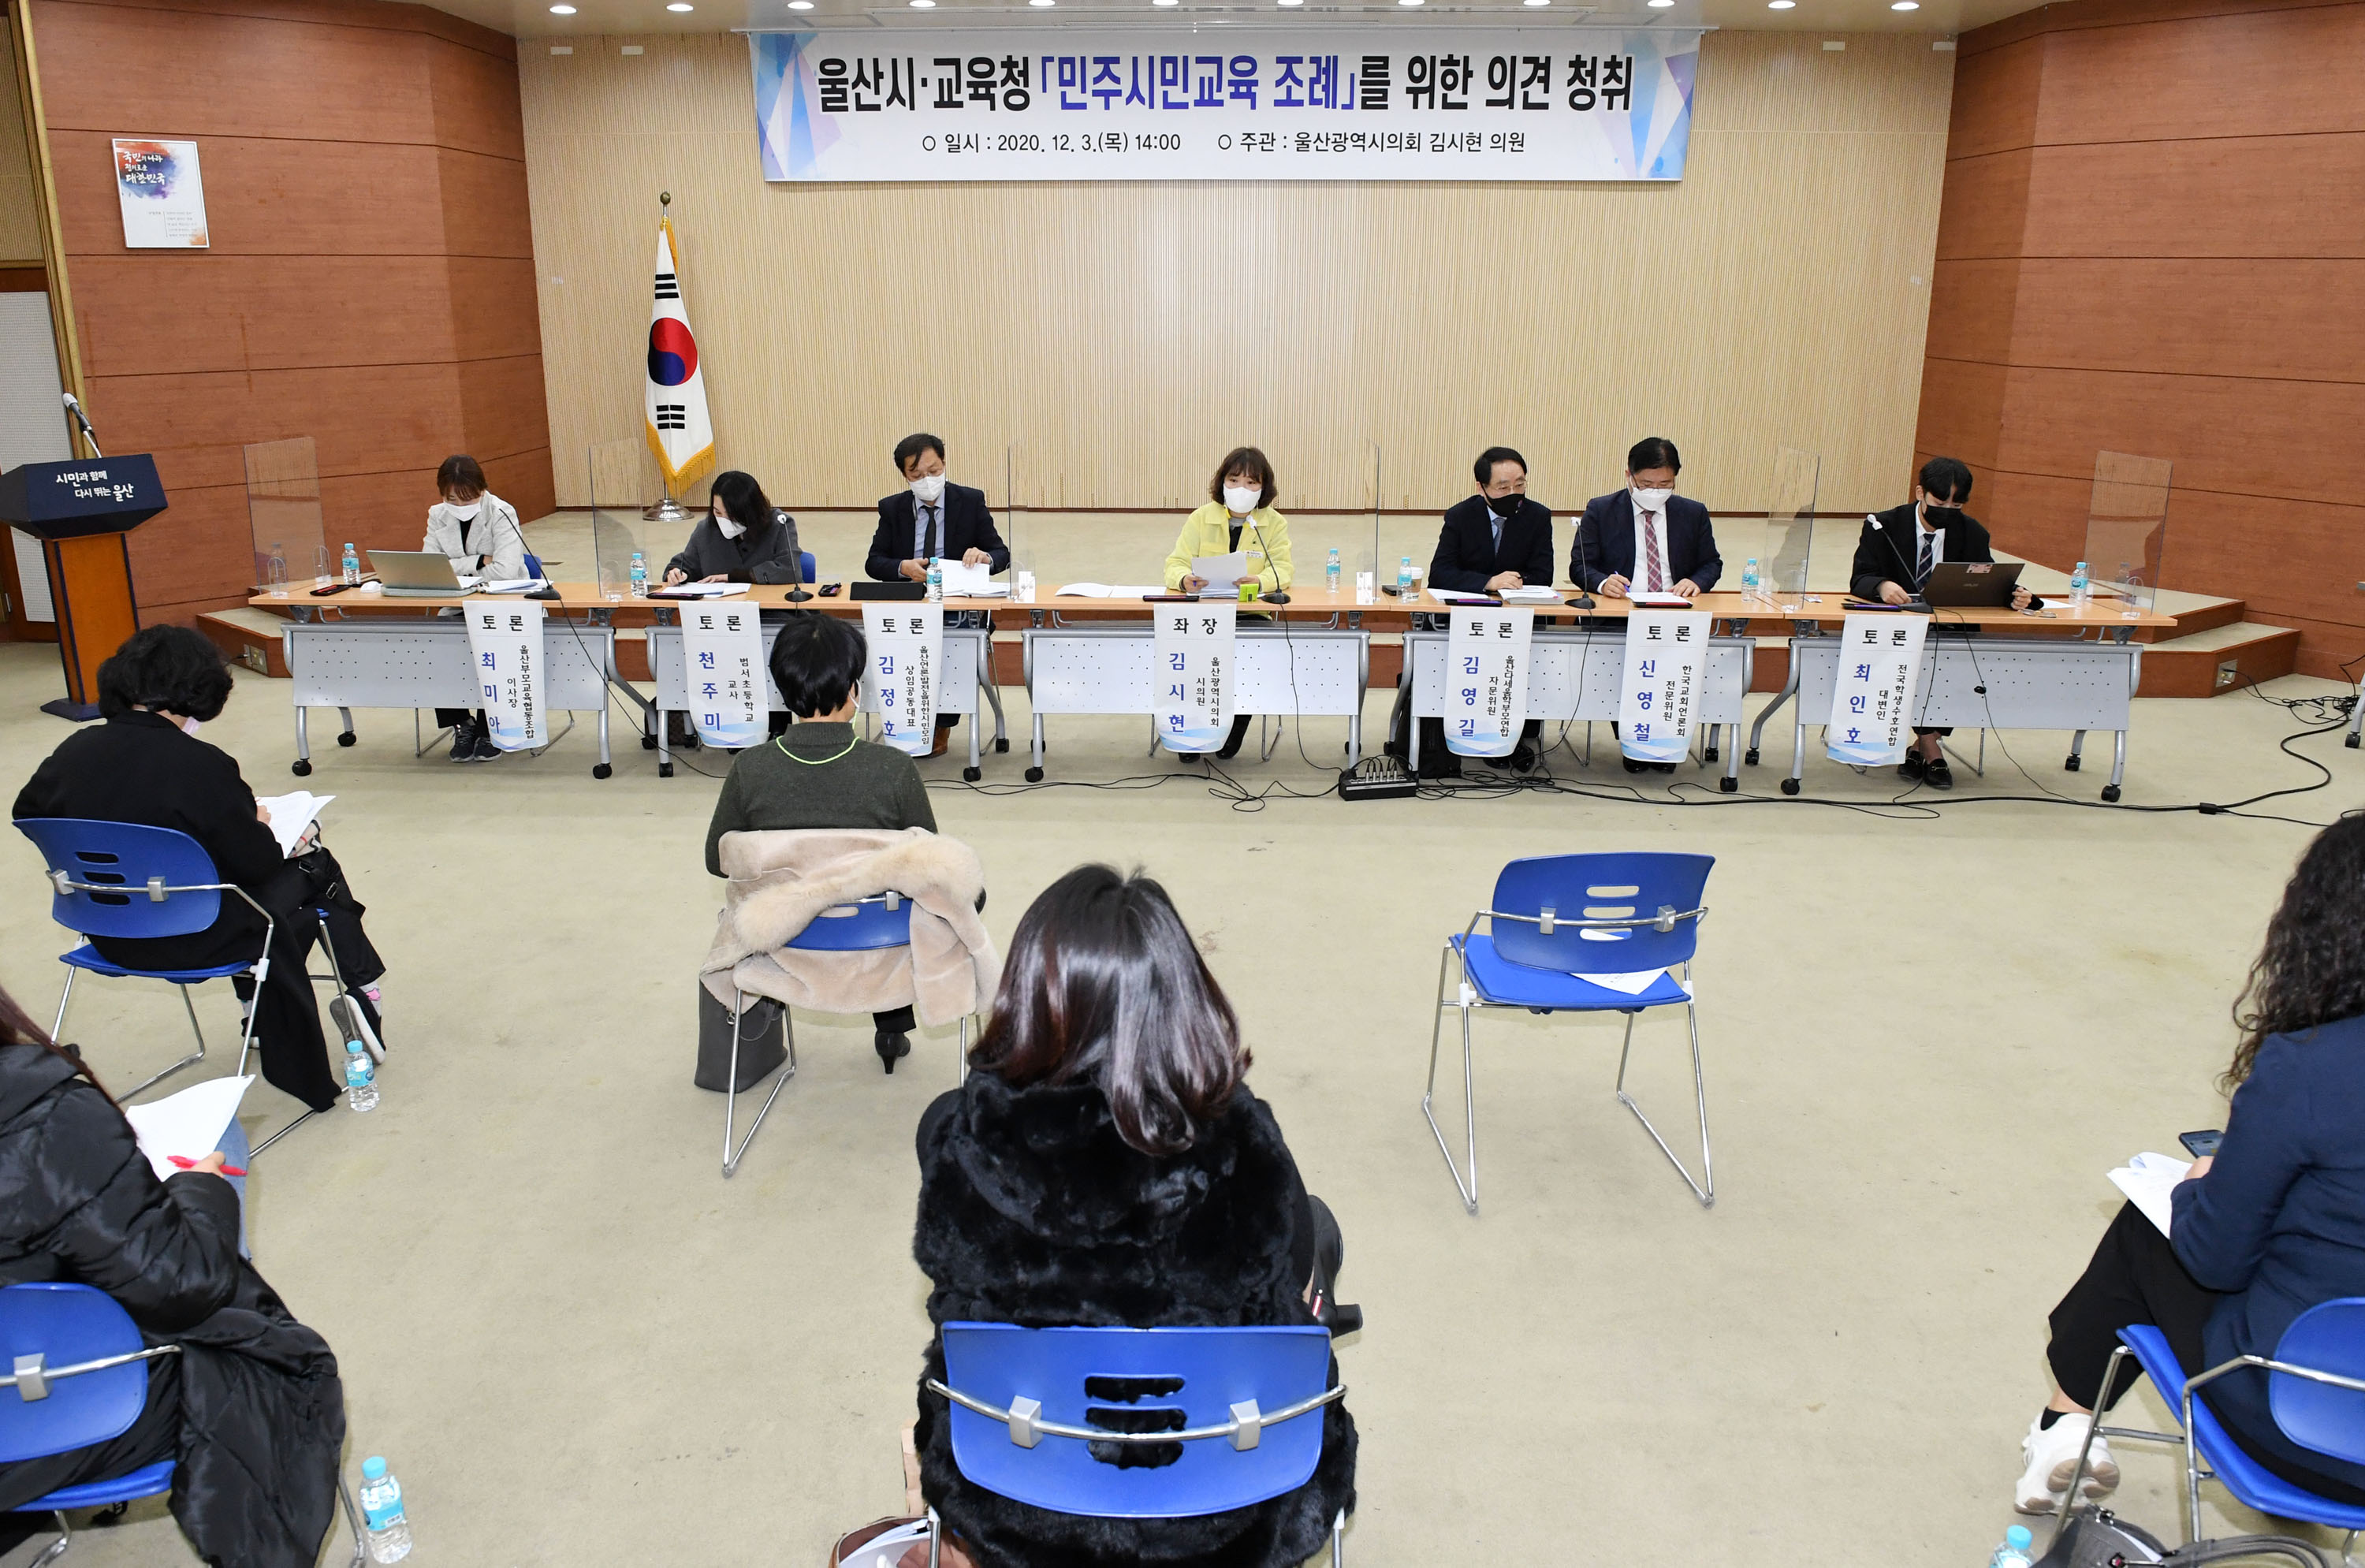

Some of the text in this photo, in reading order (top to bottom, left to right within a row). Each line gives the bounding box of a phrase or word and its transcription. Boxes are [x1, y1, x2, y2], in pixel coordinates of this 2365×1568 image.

[1406, 54, 1473, 110] 위한
[1485, 55, 1551, 110] 의견
[1567, 54, 1633, 111] 청취
[123, 151, 147, 162] 국민의
[945, 133, 980, 153] 일시
[997, 135, 1045, 153] 2020.
[1052, 135, 1074, 153] 12.
[1135, 134, 1181, 151] 14:00
[1240, 132, 1276, 152] 주관
[1294, 132, 1421, 152] 울산광역시의회
[1429, 132, 1482, 152] 김시현
[1490, 132, 1525, 152] 의원
[125, 173, 166, 185] 대한민국
[56, 471, 108, 487] 시민과 함께
[74, 483, 134, 502] 다시 뛰는 울산
[507, 678, 517, 708] 이사장
[520, 645, 534, 739] 울산부모교육협동조합
[728, 680, 738, 700] 교사
[739, 657, 754, 722] 범서초등학교
[905, 665, 915, 727] 상임공동대표
[1196, 677, 1205, 706] 시의원
[1210, 657, 1220, 727] 울산광역시의회
[1487, 676, 1499, 716] 자문위원
[1663, 680, 1675, 721] 전문위원
[1676, 665, 1692, 737] 한국교회언론회
[1876, 690, 1889, 720] 대변인
[1888, 665, 1907, 747] 전국학생수호연합
